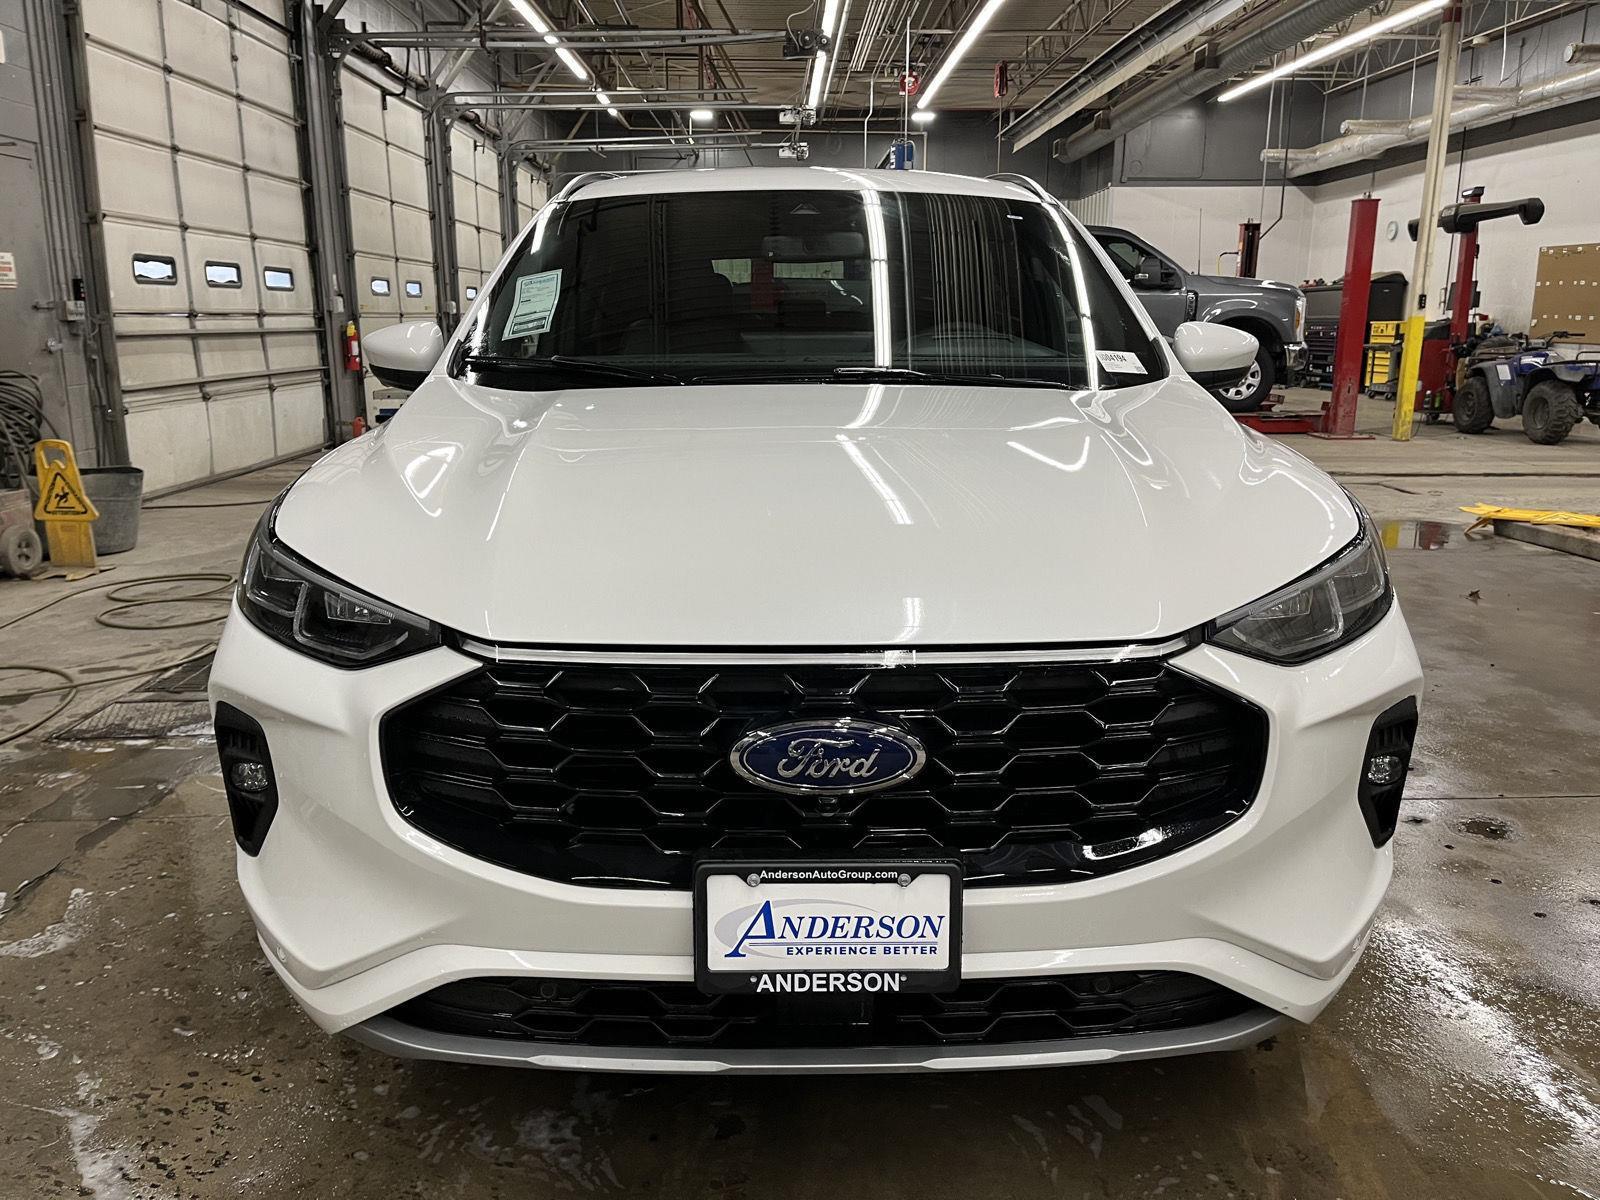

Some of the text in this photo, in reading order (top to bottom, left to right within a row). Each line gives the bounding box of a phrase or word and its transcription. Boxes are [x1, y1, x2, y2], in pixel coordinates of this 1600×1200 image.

[777, 737, 882, 779] Ford
[760, 870, 898, 880] AndersonAutoGroup.com
[724, 900, 946, 958] ANDERSON
[786, 946, 938, 956] EXPERIENCE BETTER
[756, 973, 900, 993] ANDERSON
